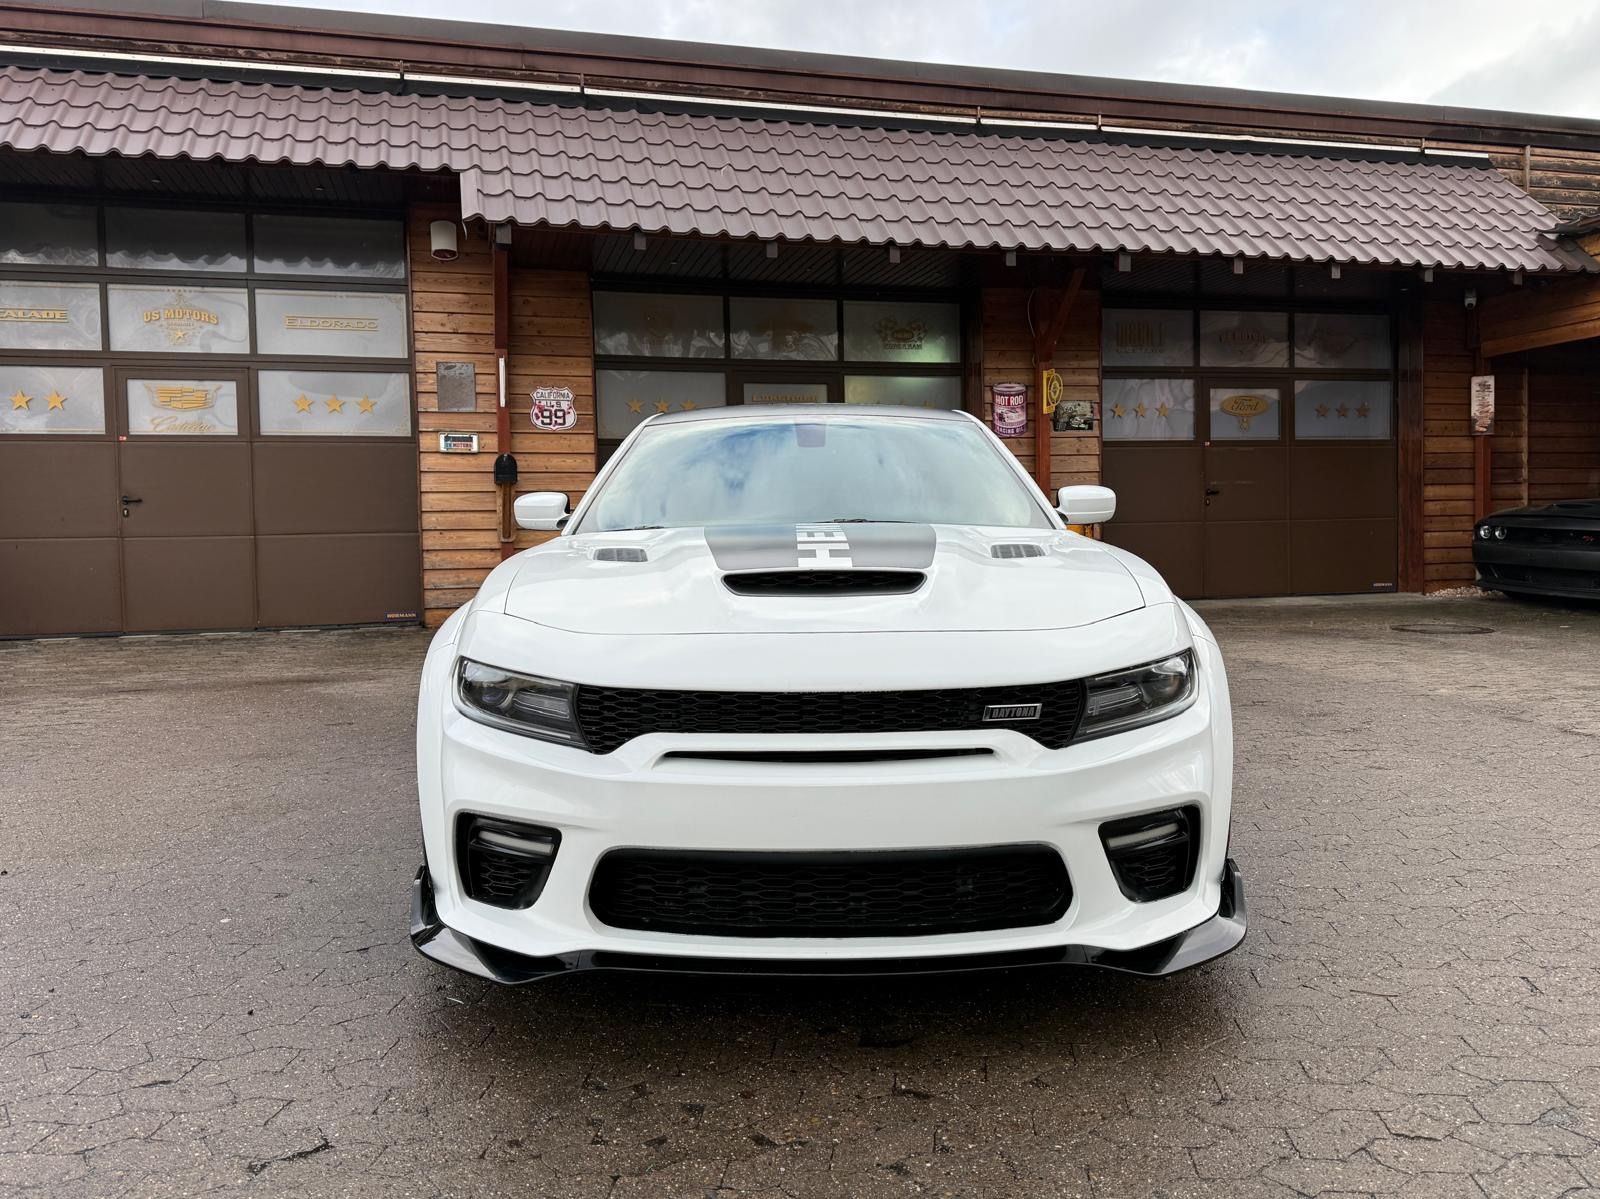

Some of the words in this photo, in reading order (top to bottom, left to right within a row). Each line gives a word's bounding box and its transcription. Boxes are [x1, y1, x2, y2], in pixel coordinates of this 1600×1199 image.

[143, 310, 161, 324] US
[164, 308, 219, 326] MOTORS
[285, 317, 379, 330] ELDORADO
[535, 391, 571, 400] CALIFORNIA
[995, 395, 1009, 407] HOT
[1010, 395, 1024, 406] ROD
[1231, 398, 1260, 412] Ford
[541, 409, 566, 426] 99
[991, 706, 1035, 718] DAYTONA
